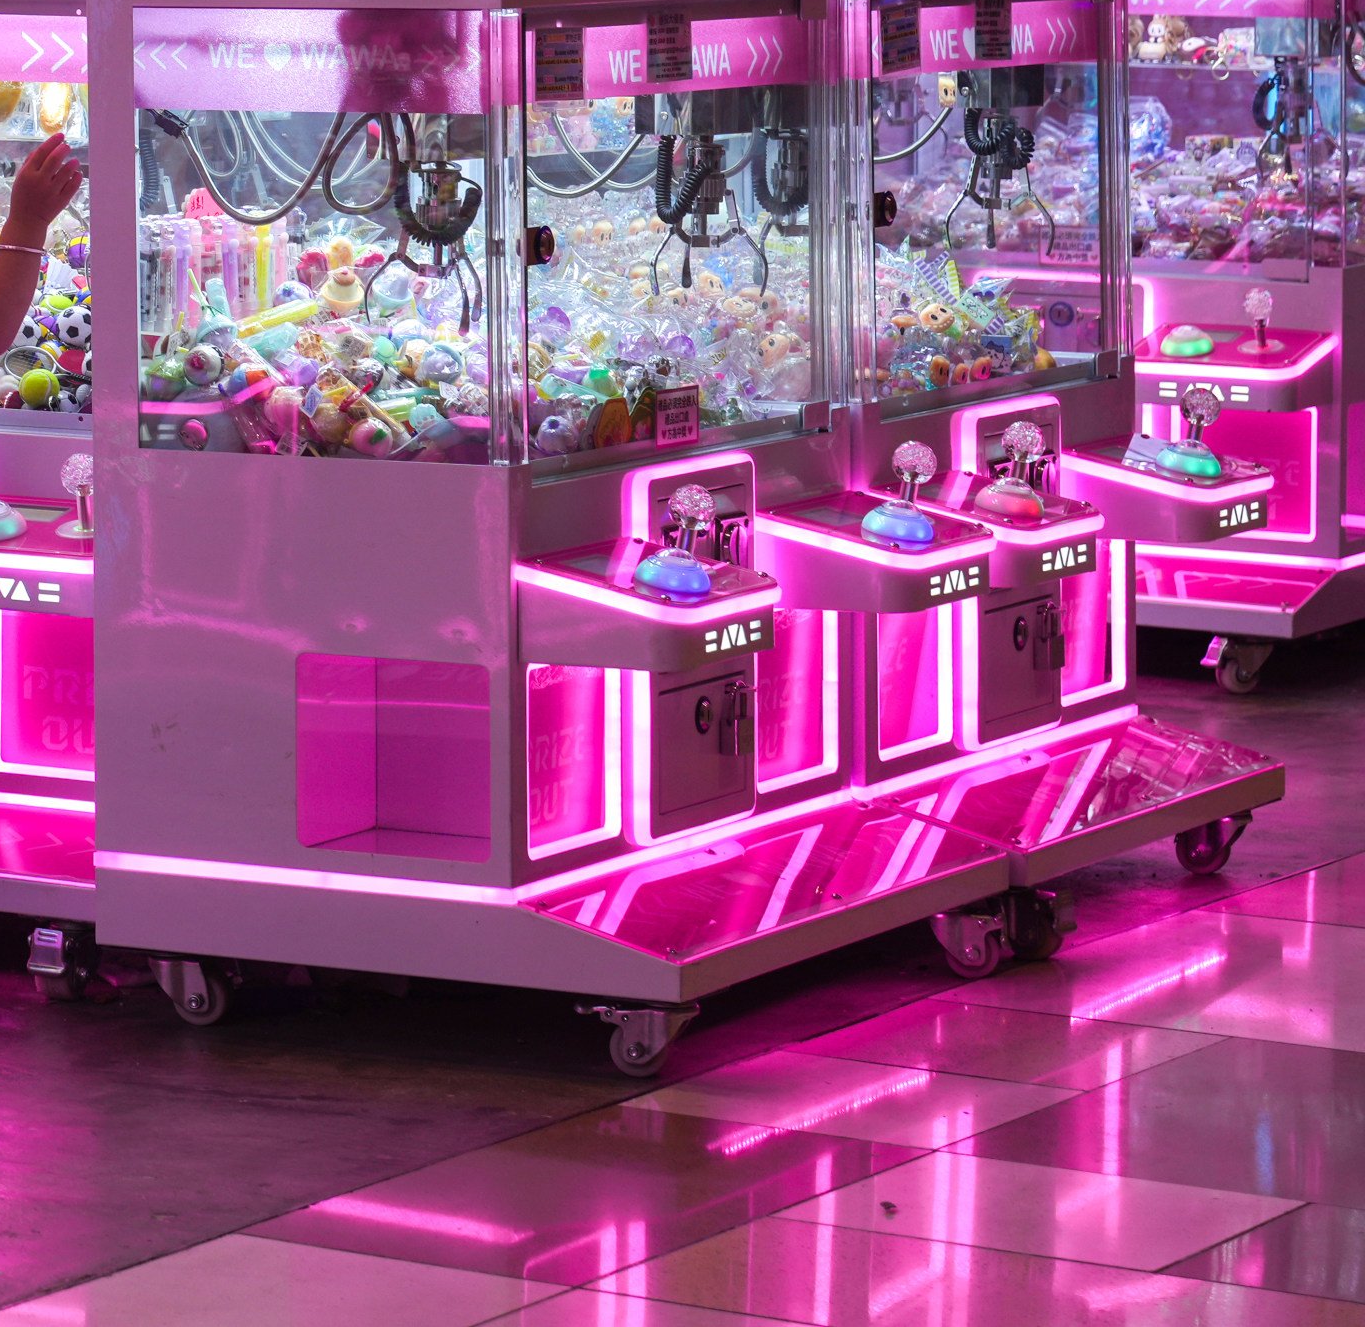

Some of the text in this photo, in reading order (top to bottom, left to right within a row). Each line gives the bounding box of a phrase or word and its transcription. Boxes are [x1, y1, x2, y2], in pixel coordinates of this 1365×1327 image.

[207, 42, 397, 71] WE WAWA
[930, 31, 959, 63] WE
[1011, 24, 1035, 54] WA
[609, 50, 642, 85] WE
[690, 42, 732, 77] AWA
[41, 716, 94, 753] OU
